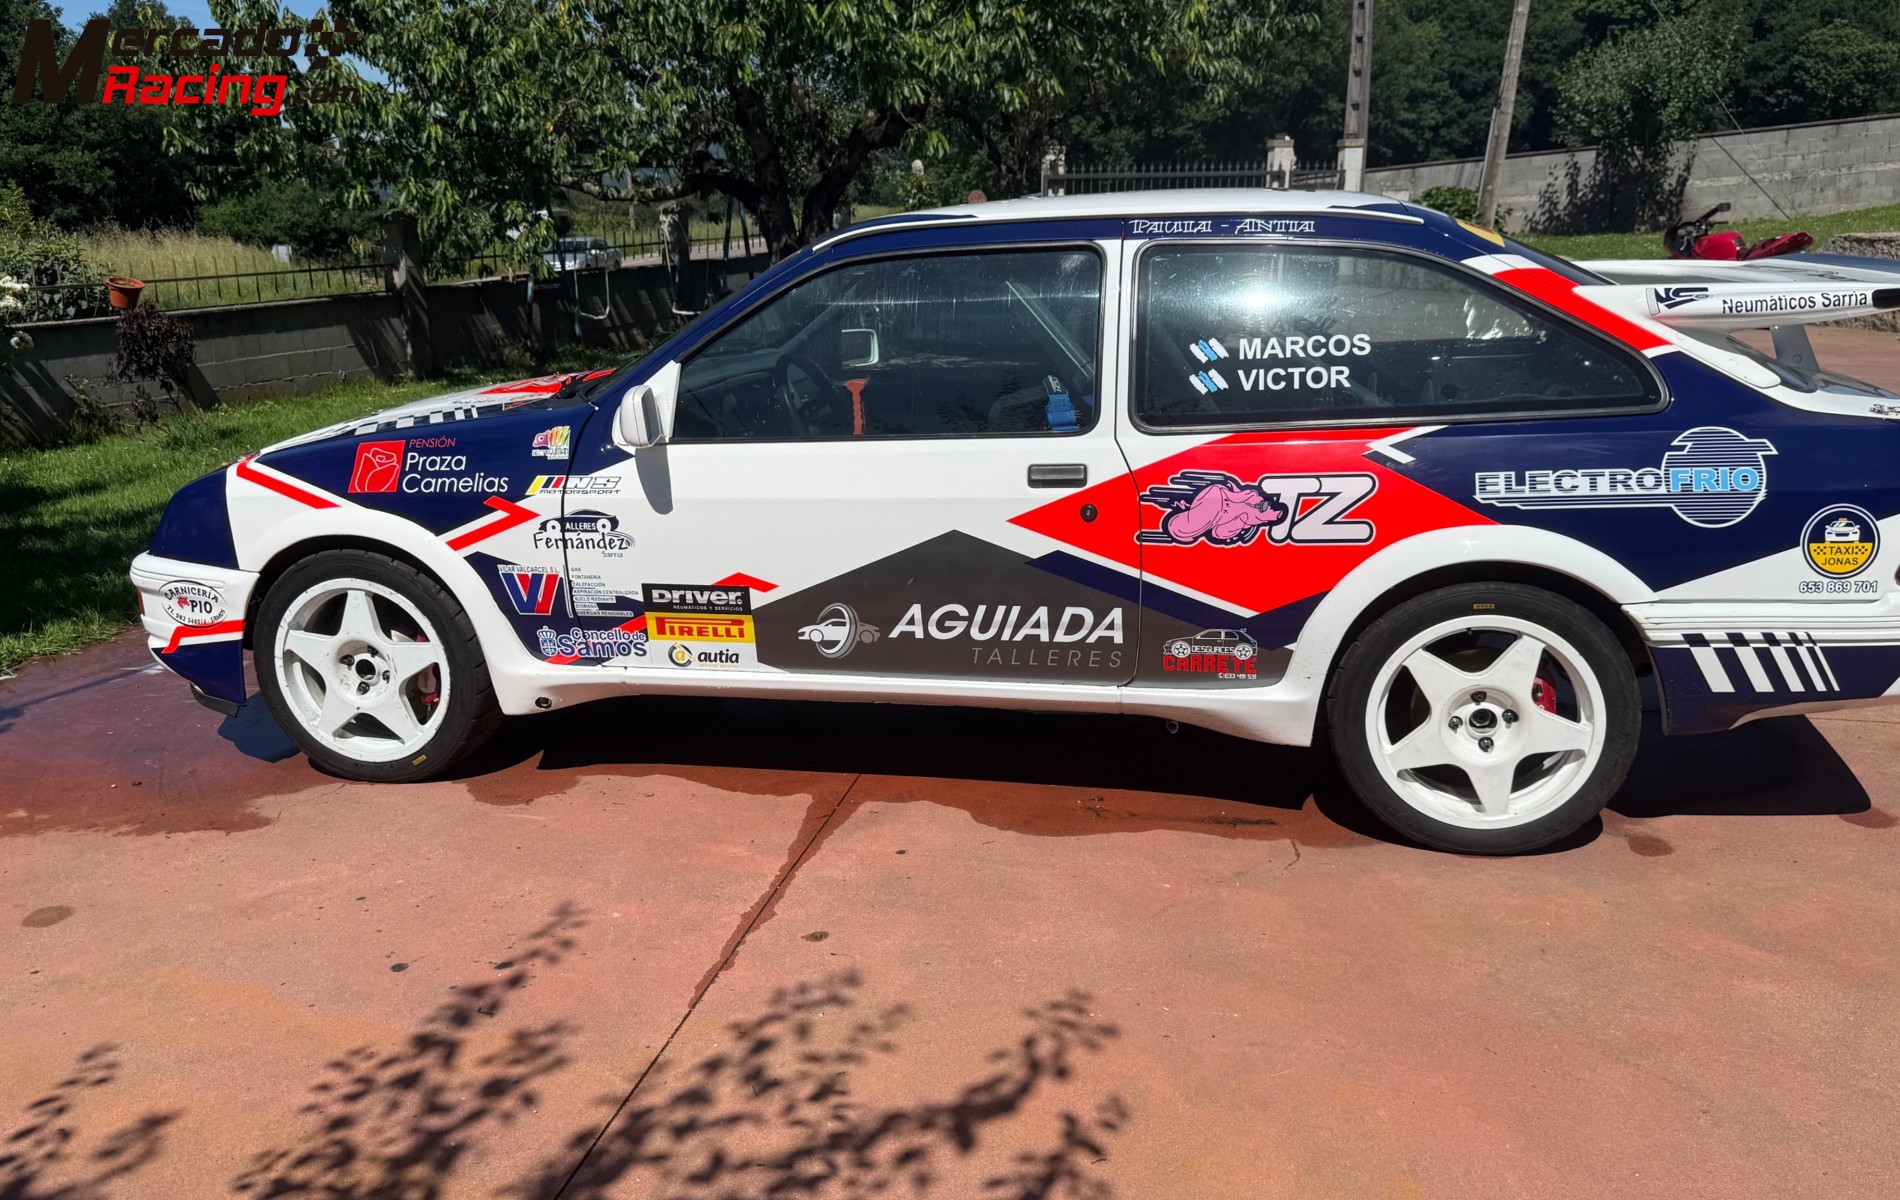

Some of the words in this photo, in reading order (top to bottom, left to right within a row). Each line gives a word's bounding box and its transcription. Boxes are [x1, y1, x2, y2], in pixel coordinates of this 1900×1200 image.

[1722, 295, 1817, 314] Neumáticos
[1239, 334, 1372, 360] MARCOS
[1237, 366, 1351, 391] VICTOR
[409, 436, 456, 448] PENSIÓN
[405, 452, 467, 471] Praza
[402, 472, 509, 493] Camelias
[1260, 474, 1377, 544] TZ
[561, 522, 596, 530] ALLERES
[533, 531, 630, 551] Fernández
[1829, 546, 1855, 555] TAXI
[1821, 557, 1859, 566] JONAS
[164, 586, 219, 603] CARNICERÍA
[1799, 581, 1824, 593] 653
[1826, 581, 1852, 593] 869
[1854, 580, 1878, 593] 701
[651, 589, 742, 605] Driver
[189, 600, 213, 614] PIO
[655, 617, 745, 638] PIRELLI
[888, 603, 1124, 644] AGUIADA
[571, 628, 631, 641] Concello
[632, 631, 646, 642] de
[557, 635, 648, 658] Samos
[698, 649, 739, 663] autia
[1191, 645, 1236, 654] DESGUACES
[971, 647, 1122, 668] TALLERES
[1163, 654, 1257, 674] CARRETE
